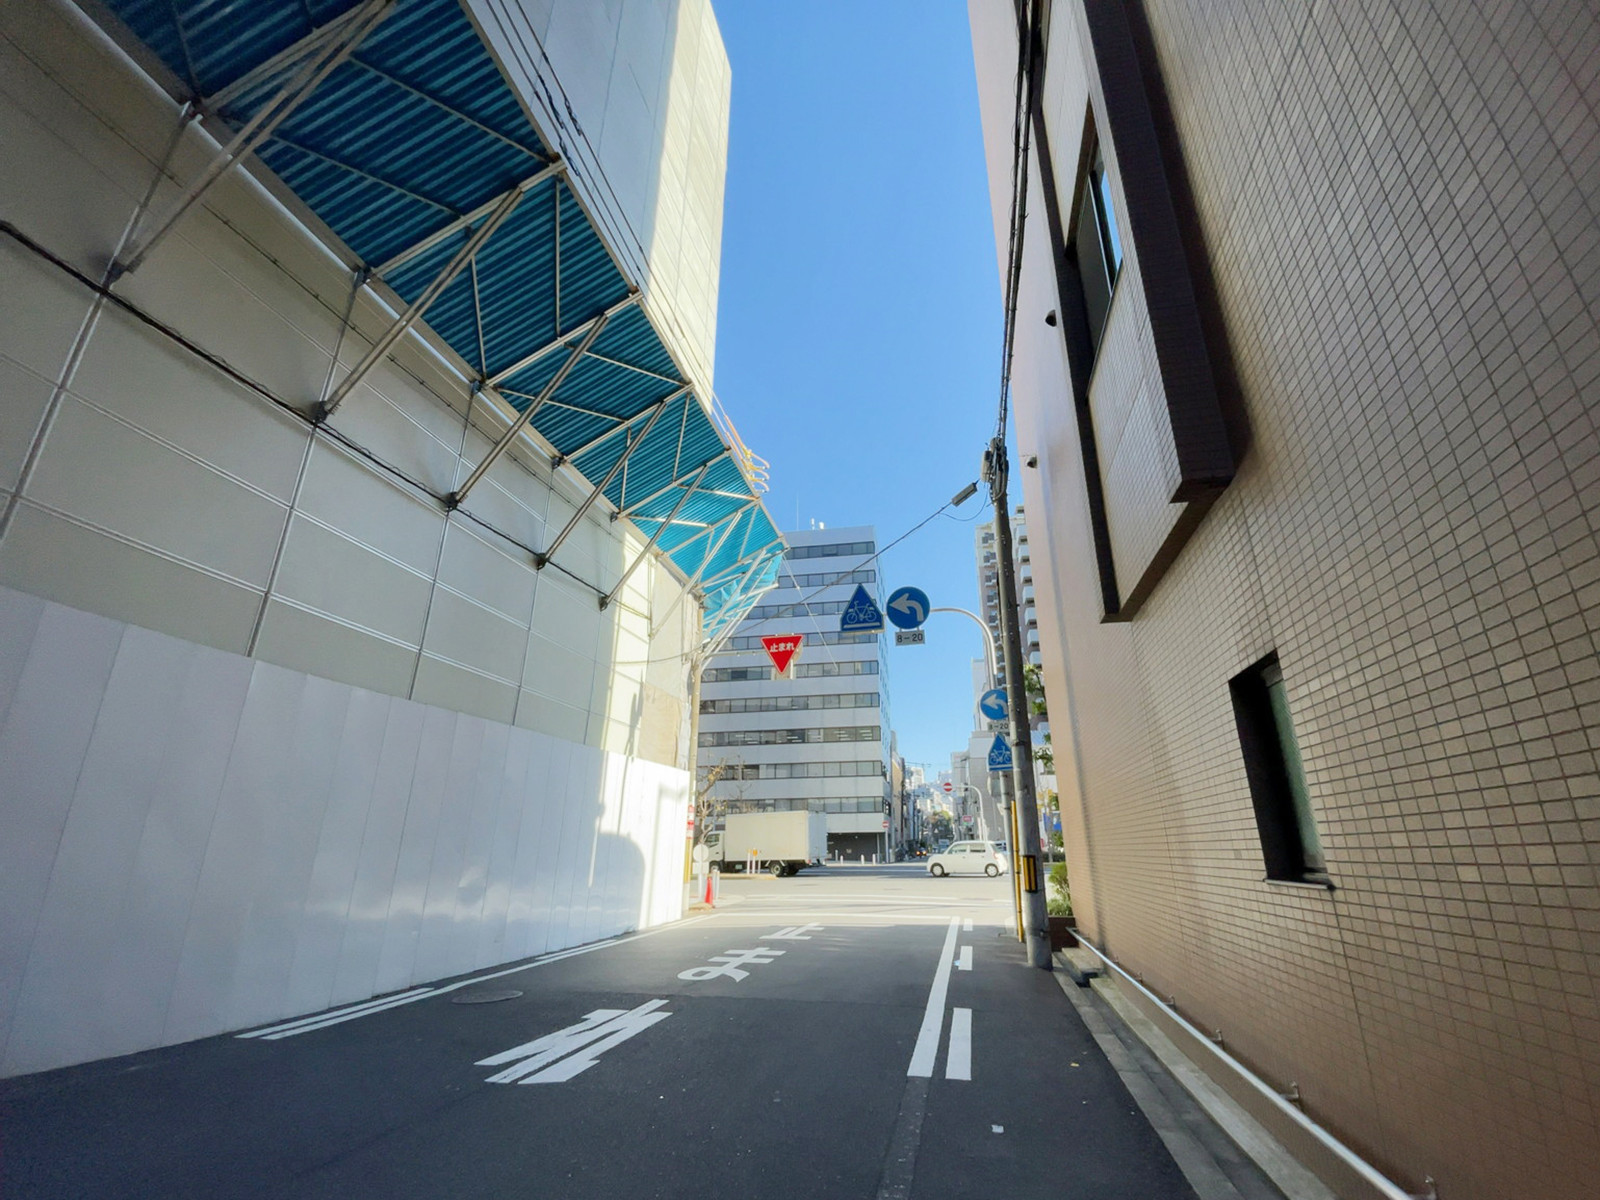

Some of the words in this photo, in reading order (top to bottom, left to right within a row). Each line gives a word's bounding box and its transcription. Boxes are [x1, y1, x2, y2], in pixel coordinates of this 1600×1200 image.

[896, 633, 923, 643] 8-20
[769, 642, 795, 653] 止まれ
[473, 921, 826, 1084] 止まれ
